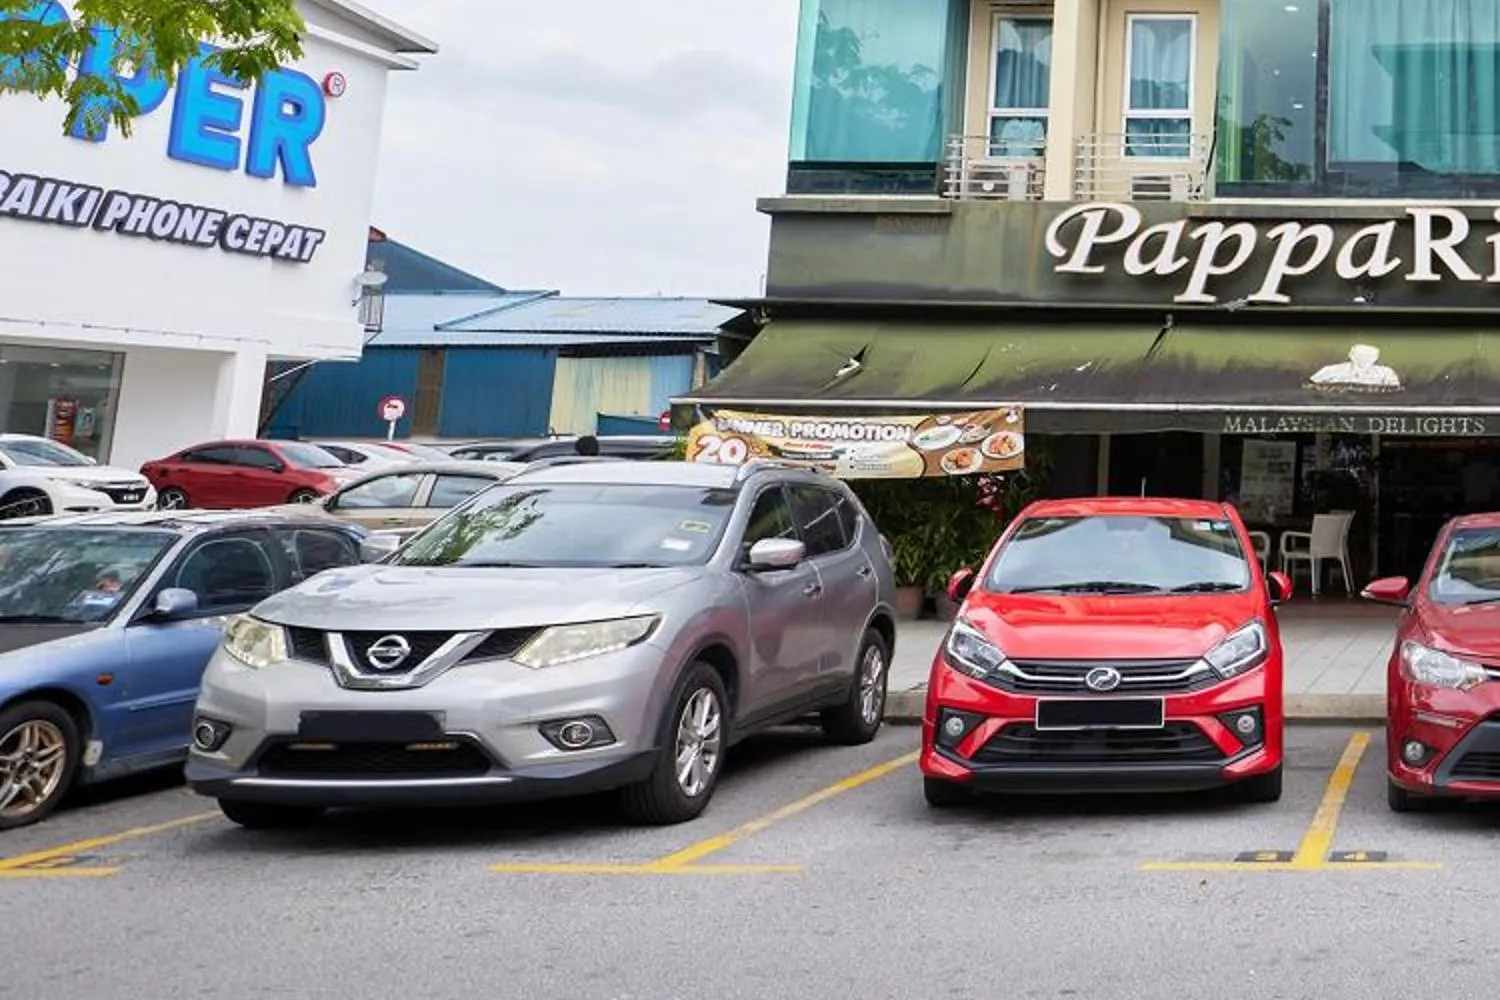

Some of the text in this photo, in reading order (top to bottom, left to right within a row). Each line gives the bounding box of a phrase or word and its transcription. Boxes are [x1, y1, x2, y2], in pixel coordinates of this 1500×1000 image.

[102, 193, 227, 244] PHONE
[225, 216, 324, 261] CEPAT
[790, 420, 914, 442] PROMOTION
[1222, 415, 1486, 435] MALAYSIAN DELIGHTS
